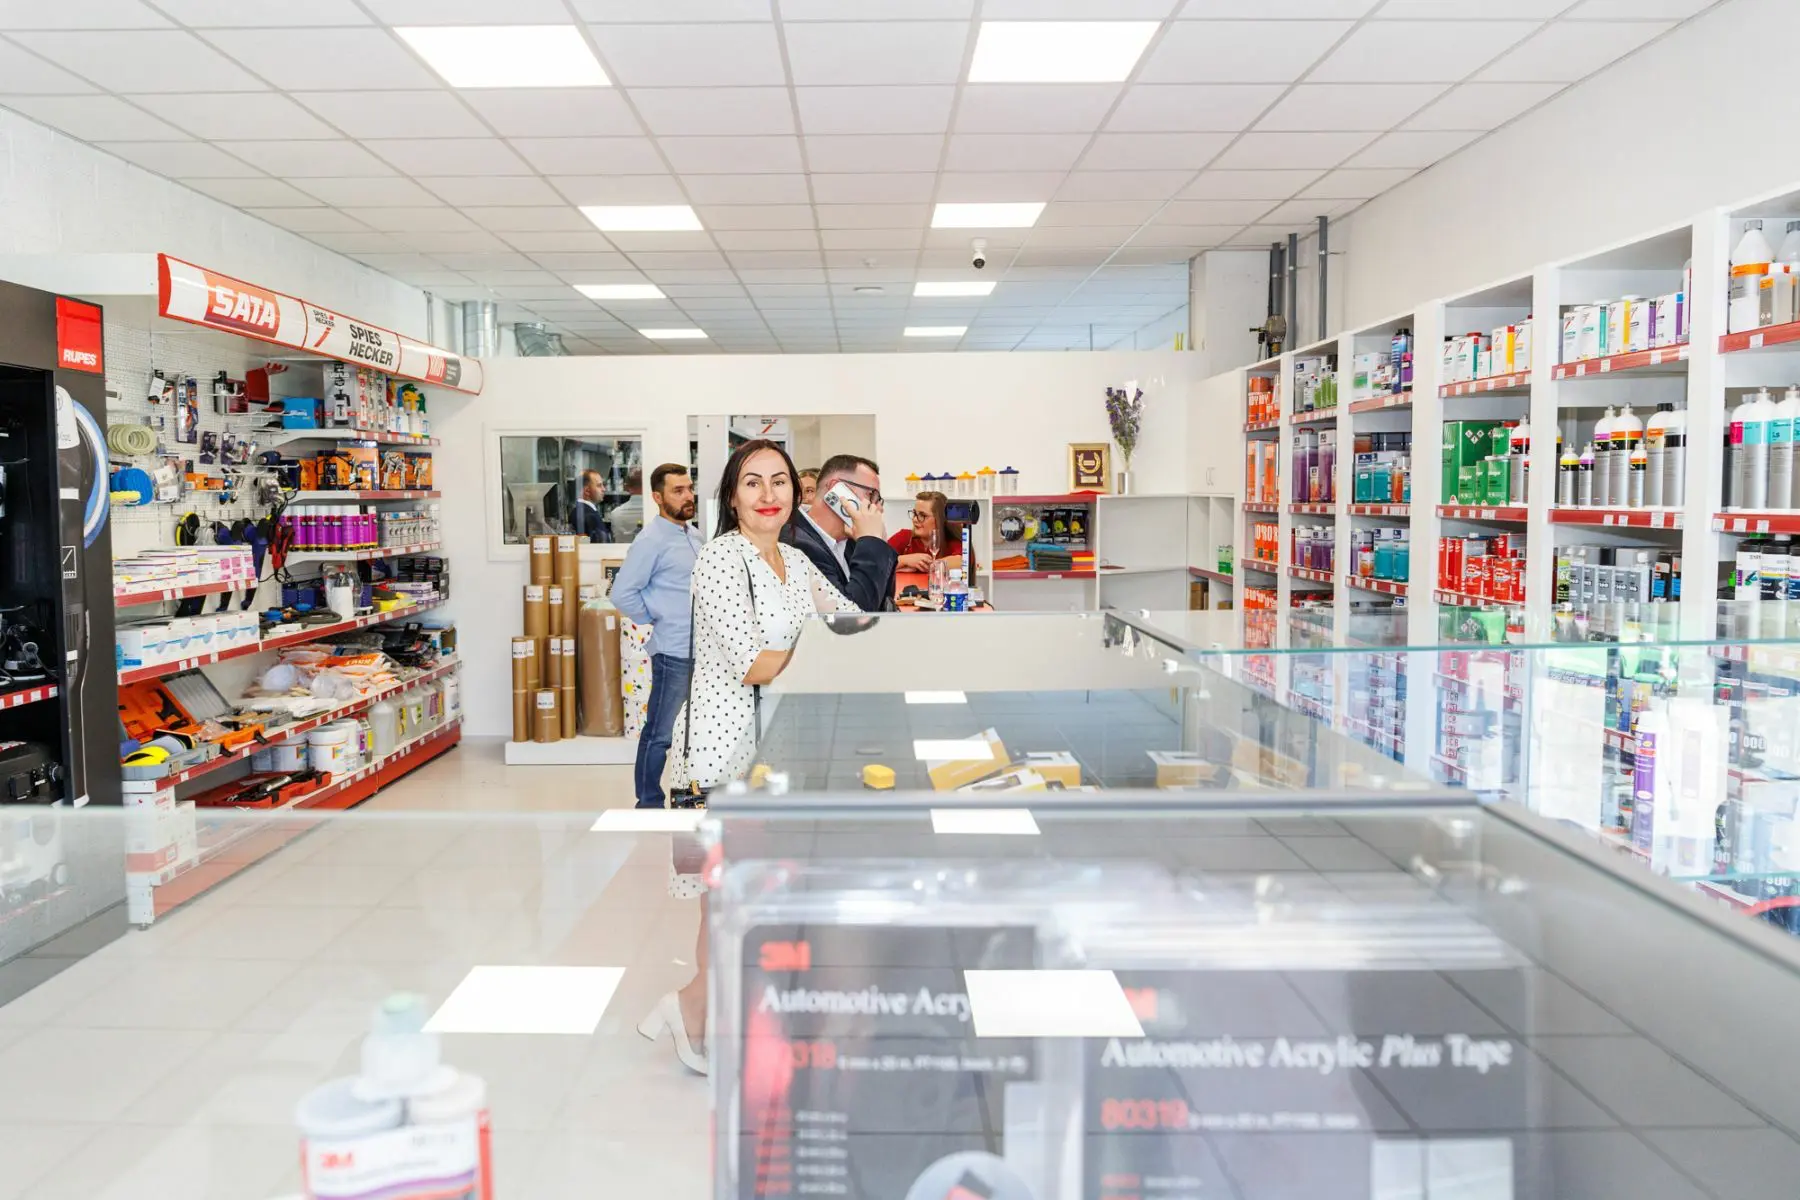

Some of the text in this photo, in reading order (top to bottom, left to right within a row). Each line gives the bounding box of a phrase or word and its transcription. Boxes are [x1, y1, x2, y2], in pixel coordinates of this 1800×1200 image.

[212, 285, 275, 330] SATA
[350, 323, 382, 347] SPIES
[63, 348, 97, 367] RUPES
[349, 341, 394, 366] HECKER
[759, 940, 811, 971] 3M
[758, 984, 972, 1022] Automotive Acry
[1101, 1033, 1513, 1075] Automotive Acrylic Plus Tape
